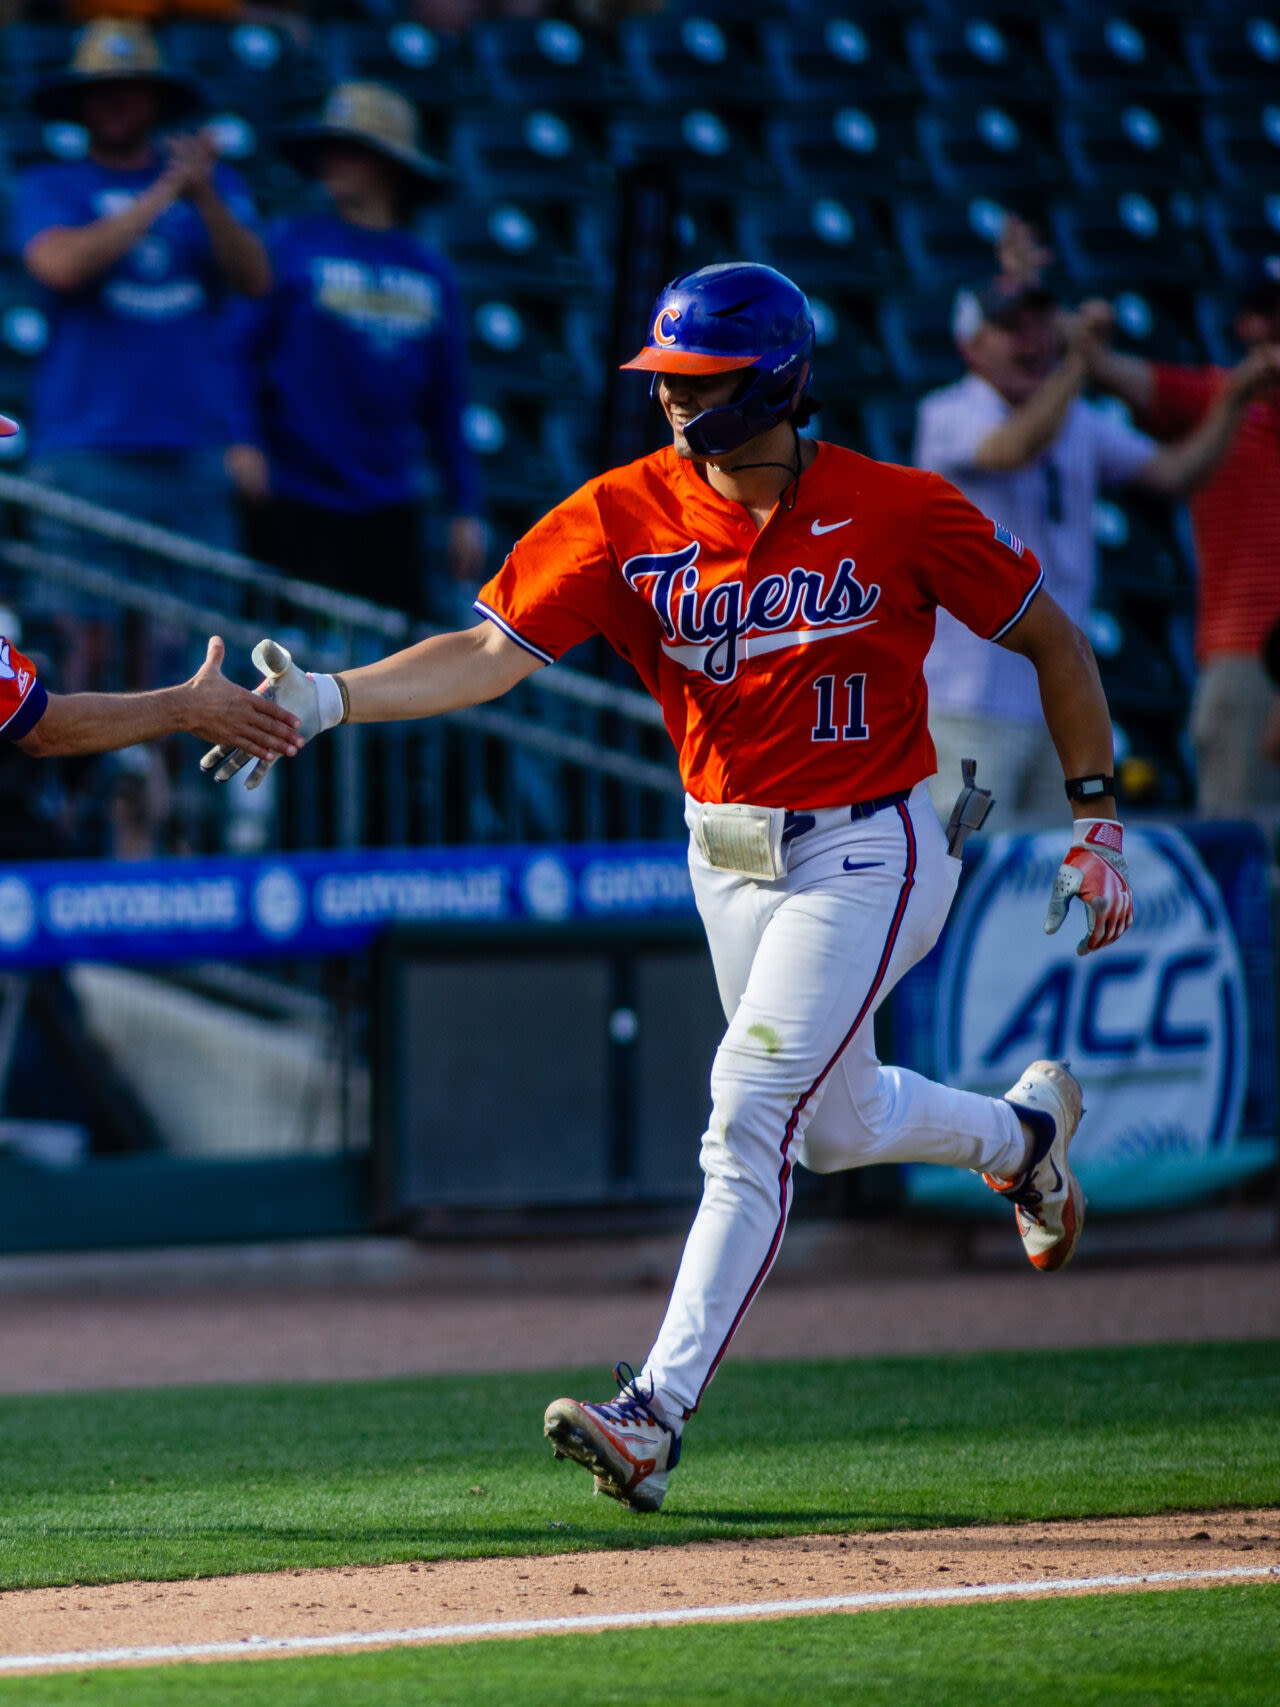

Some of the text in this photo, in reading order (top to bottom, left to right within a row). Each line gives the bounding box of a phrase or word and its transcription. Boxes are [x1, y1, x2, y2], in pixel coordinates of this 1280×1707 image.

[653, 306, 681, 347] C
[622, 540, 882, 685] Tigers
[811, 673, 870, 742] 11
[980, 951, 1213, 1066] ACC
